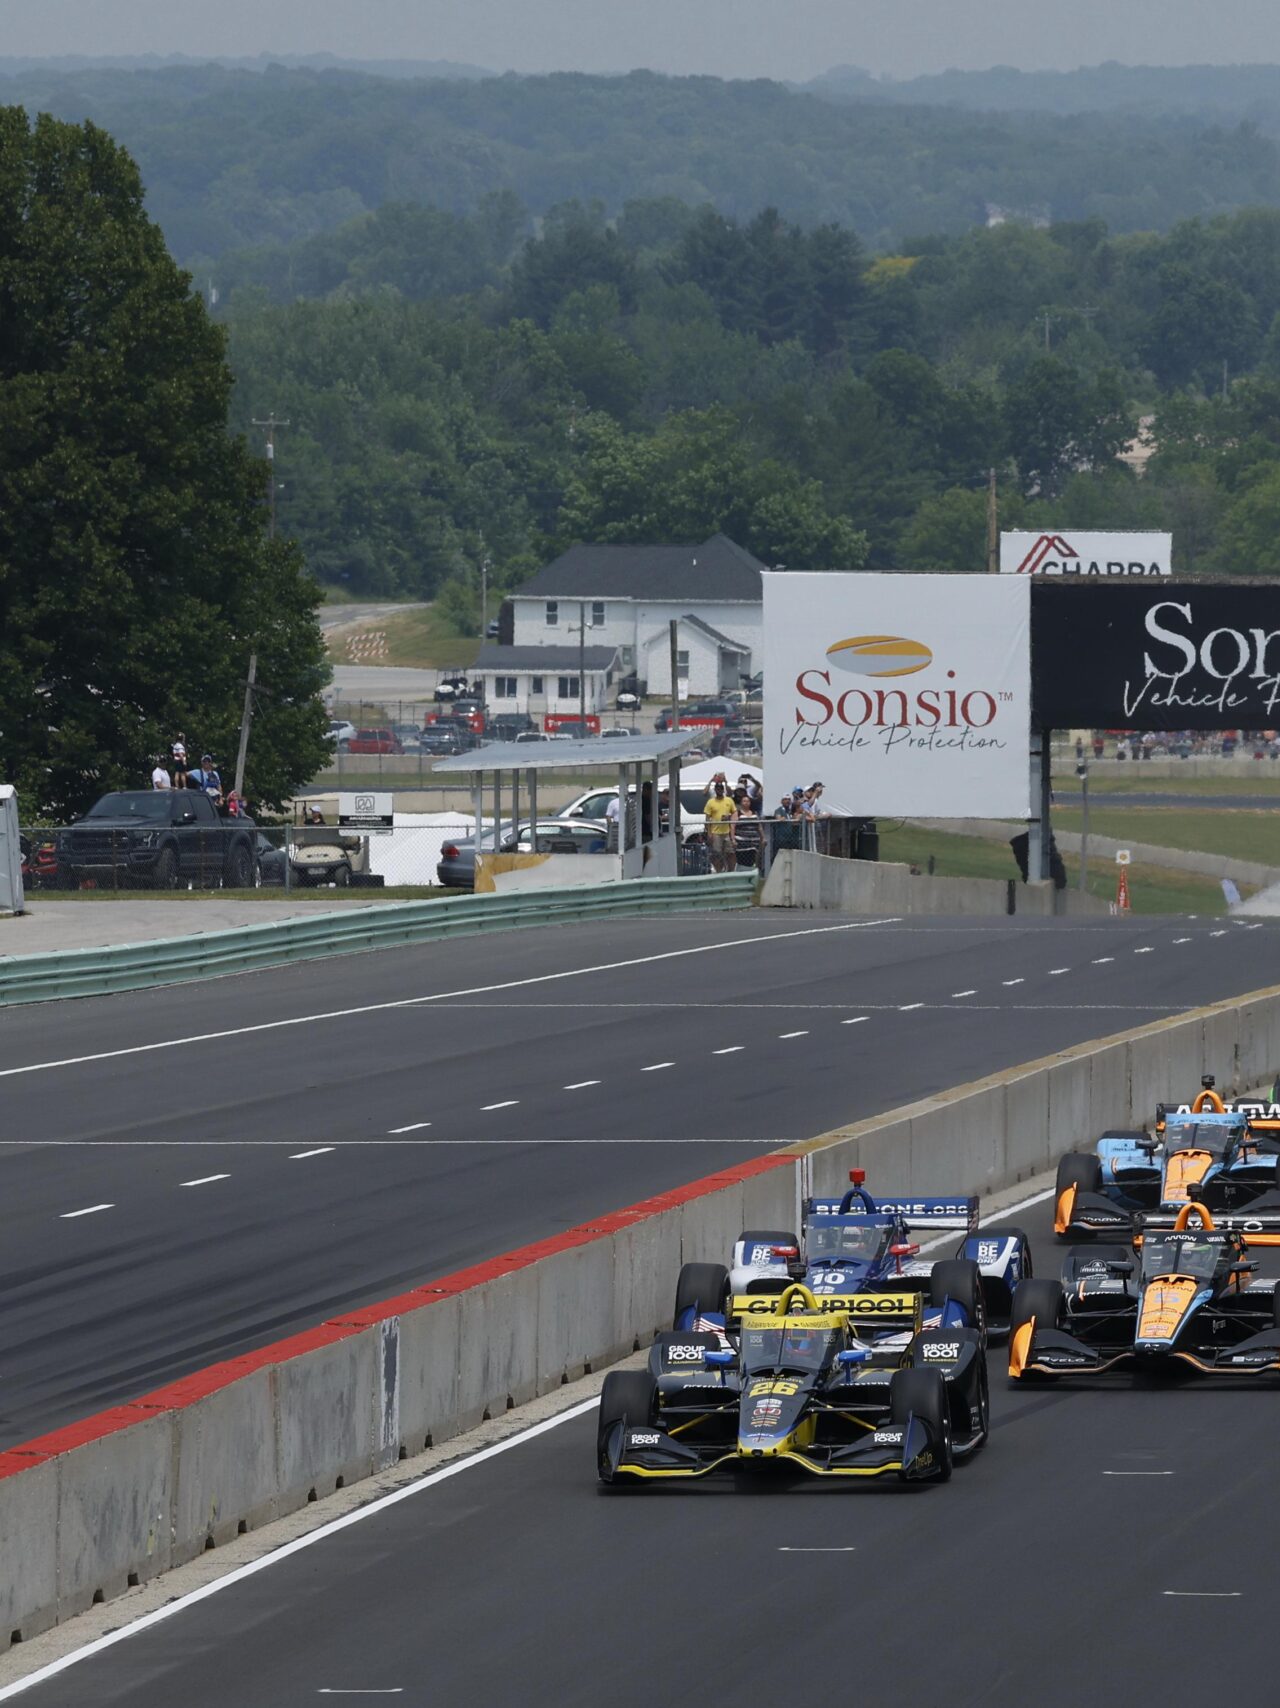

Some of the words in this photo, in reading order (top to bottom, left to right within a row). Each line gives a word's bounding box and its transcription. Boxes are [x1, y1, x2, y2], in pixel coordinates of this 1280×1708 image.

[795, 670, 997, 727] Sonsio
[1123, 672, 1248, 717] Vehicle
[779, 721, 871, 755] Vehicle
[878, 723, 1007, 754] Protection
[751, 1248, 771, 1261] BE
[978, 1245, 999, 1257] BE
[812, 1272, 846, 1286] 10
[668, 1351, 703, 1360] 1001
[922, 1349, 958, 1358] 1001
[748, 1381, 800, 1399] 26
